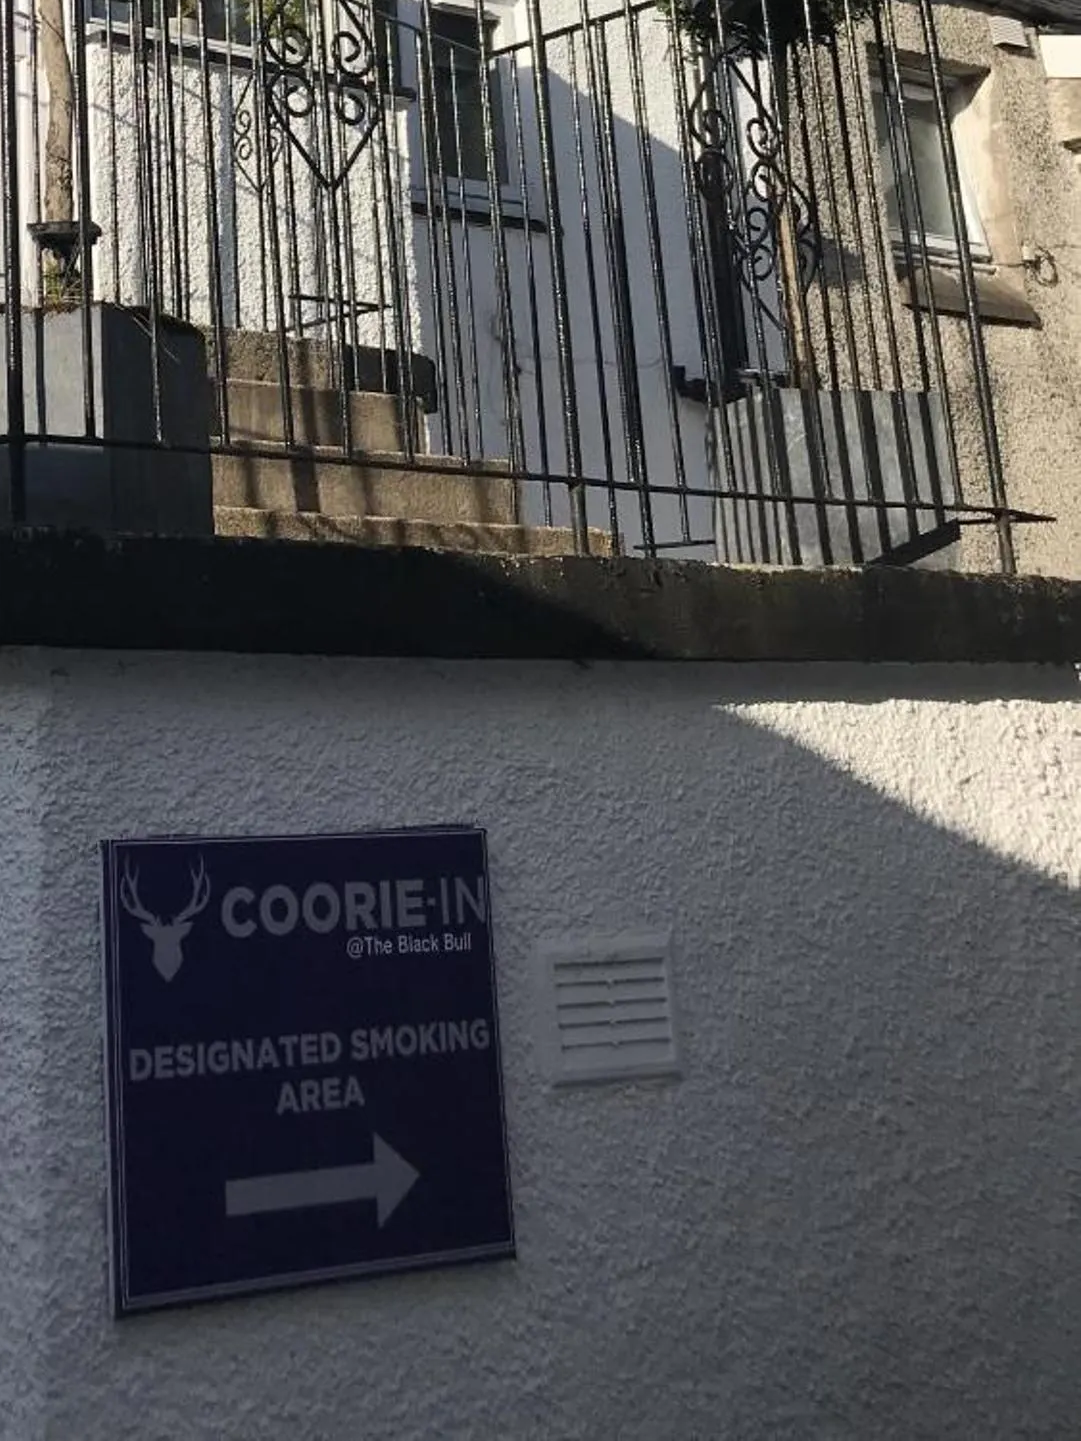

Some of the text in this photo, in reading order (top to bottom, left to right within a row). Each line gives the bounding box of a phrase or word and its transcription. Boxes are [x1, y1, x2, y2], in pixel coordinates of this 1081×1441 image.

[346, 932, 472, 959] @The Black Bull
[129, 1017, 491, 1082] DESIGNATED SMOKING
[276, 1075, 366, 1116] AREA
